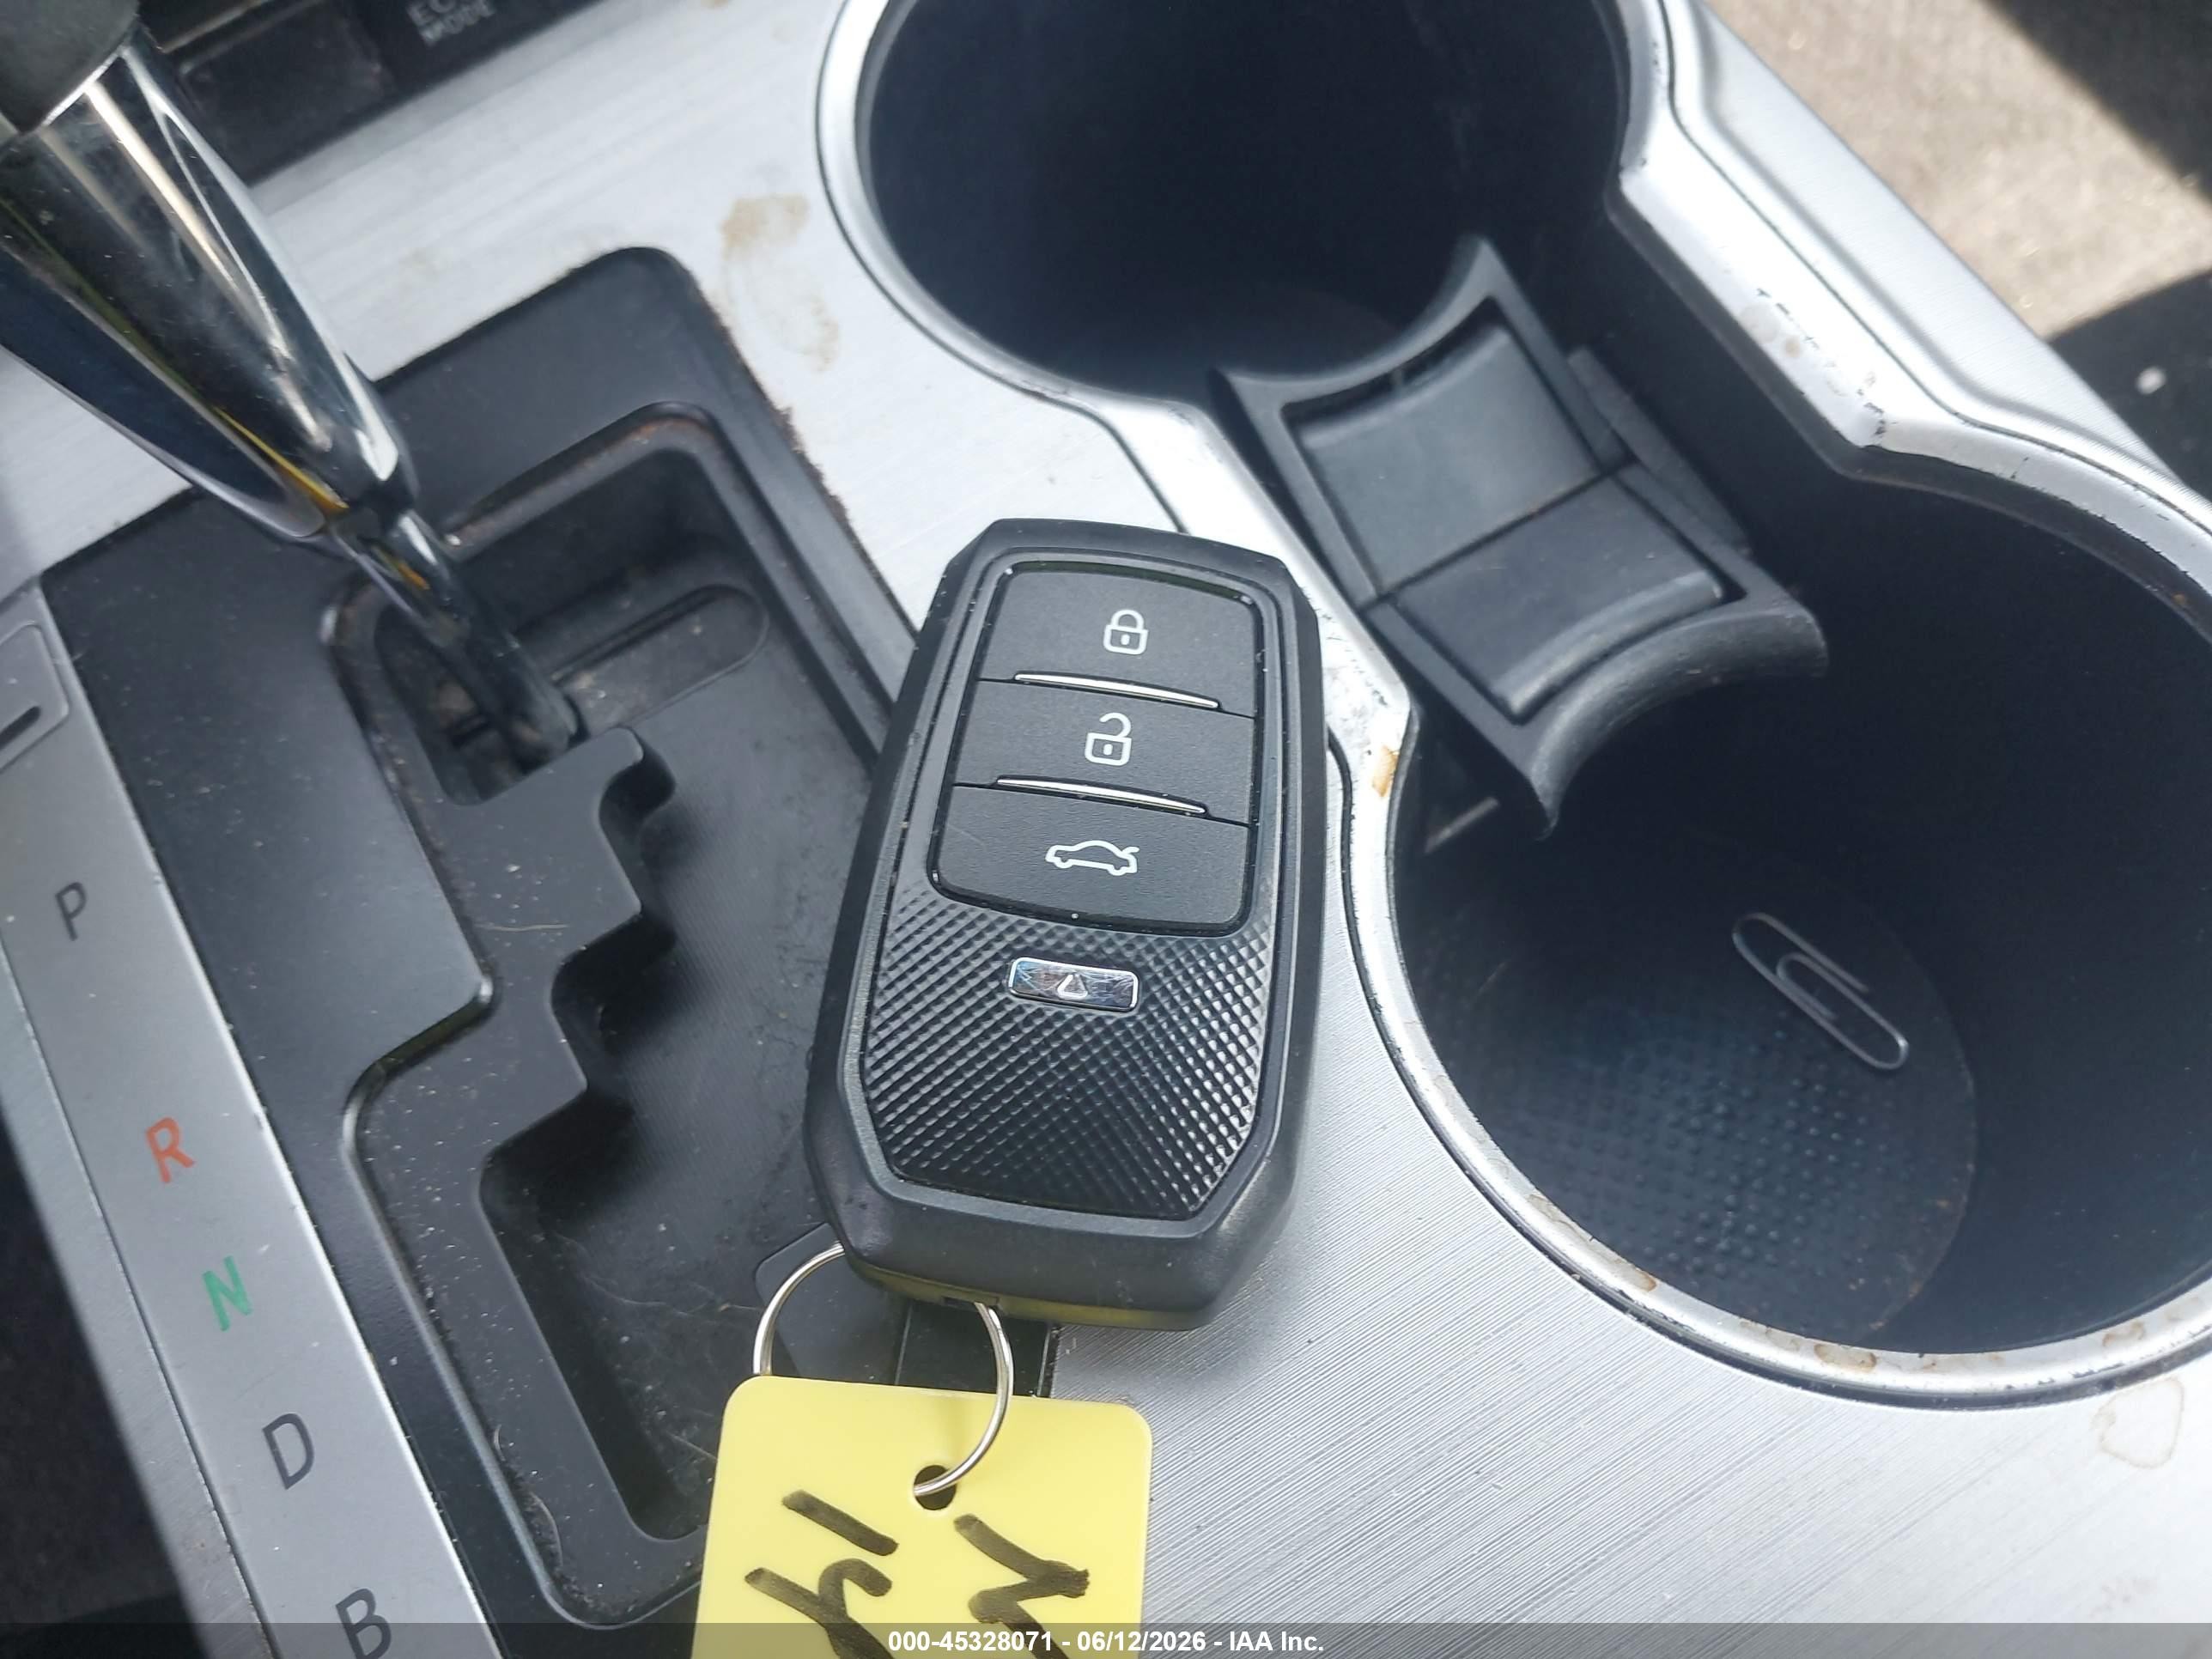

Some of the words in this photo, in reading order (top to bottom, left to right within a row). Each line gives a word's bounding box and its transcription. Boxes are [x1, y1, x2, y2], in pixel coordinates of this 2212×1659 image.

[55, 882, 88, 941] P
[145, 1116, 196, 1183] R
[201, 1255, 253, 1332] N
[261, 1412, 315, 1490] D
[335, 1588, 392, 1659] B
